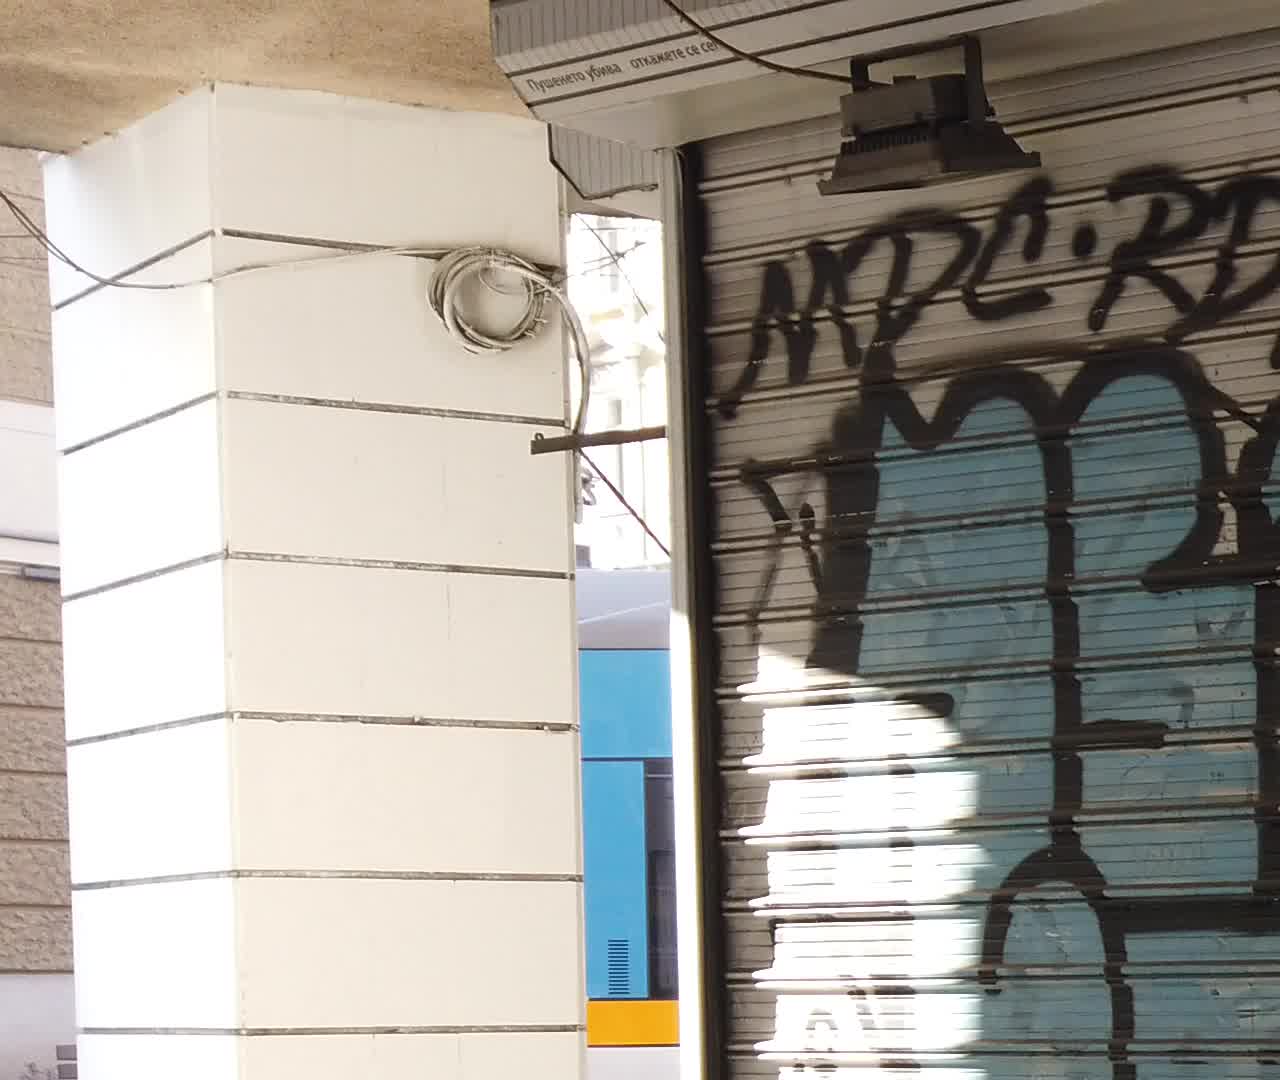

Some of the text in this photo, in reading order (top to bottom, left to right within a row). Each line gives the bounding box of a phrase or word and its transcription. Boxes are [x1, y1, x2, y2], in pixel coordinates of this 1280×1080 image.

[526, 72, 586, 95] Пушенето
[585, 62, 623, 82] убива
[629, 47, 686, 69] откажете
[686, 44, 700, 57] се
